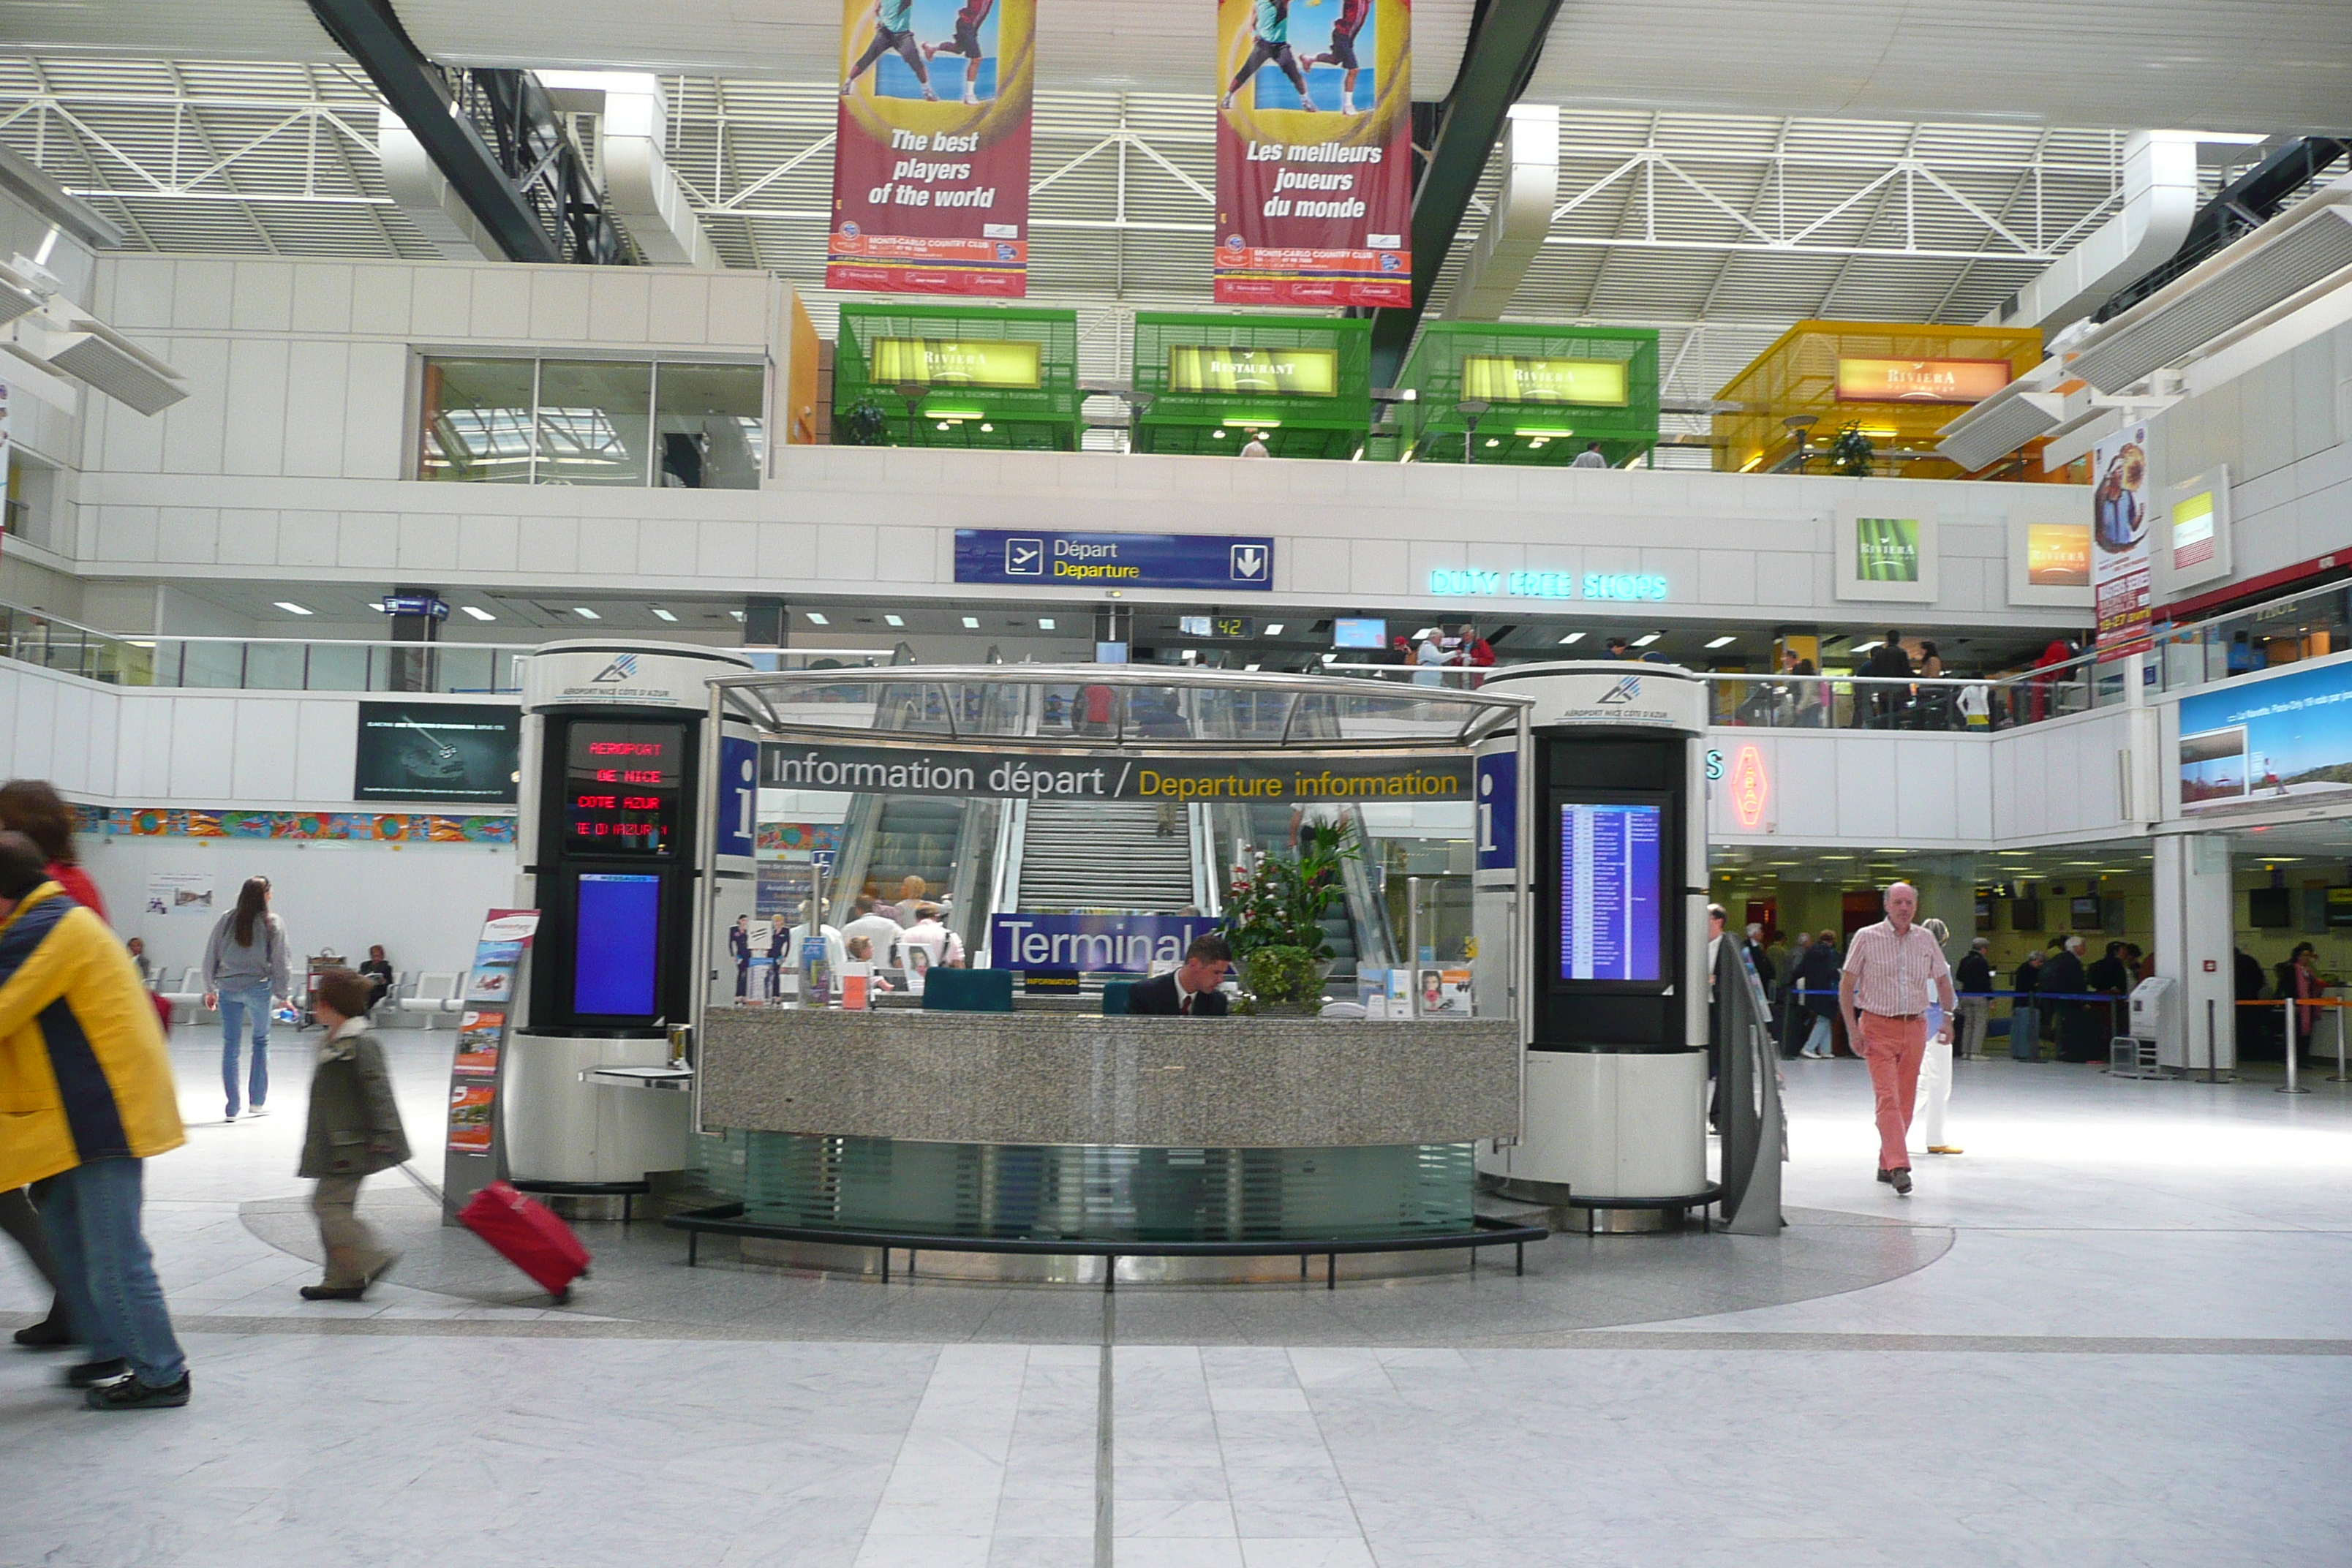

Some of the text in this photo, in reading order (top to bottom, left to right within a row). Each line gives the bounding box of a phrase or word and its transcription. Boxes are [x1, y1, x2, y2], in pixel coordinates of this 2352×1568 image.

[892, 129, 979, 152] The best
[1246, 140, 1383, 164] Les meilleurs
[892, 158, 972, 183] players
[1273, 168, 1354, 193] joueurs
[868, 183, 995, 208] of the world
[1263, 196, 1366, 218] du monde
[1210, 361, 1296, 375] RESTAURANT
[1888, 369, 1956, 384] RIVIERA
[1054, 540, 1117, 560] Départ
[1053, 561, 1140, 580] Departure
[1431, 570, 1667, 600] DUTY FREE SHOPS
[625, 770, 662, 783] NICE
[772, 750, 975, 791] Information
[989, 761, 1105, 799] départ
[1139, 769, 1283, 802] Departure
[1294, 769, 1458, 797] information
[1744, 753, 1758, 813] TABAC
[578, 796, 660, 810] COTE AZUR
[998, 920, 1192, 965] Terminal
[1026, 978, 1078, 986] INFORMATION
